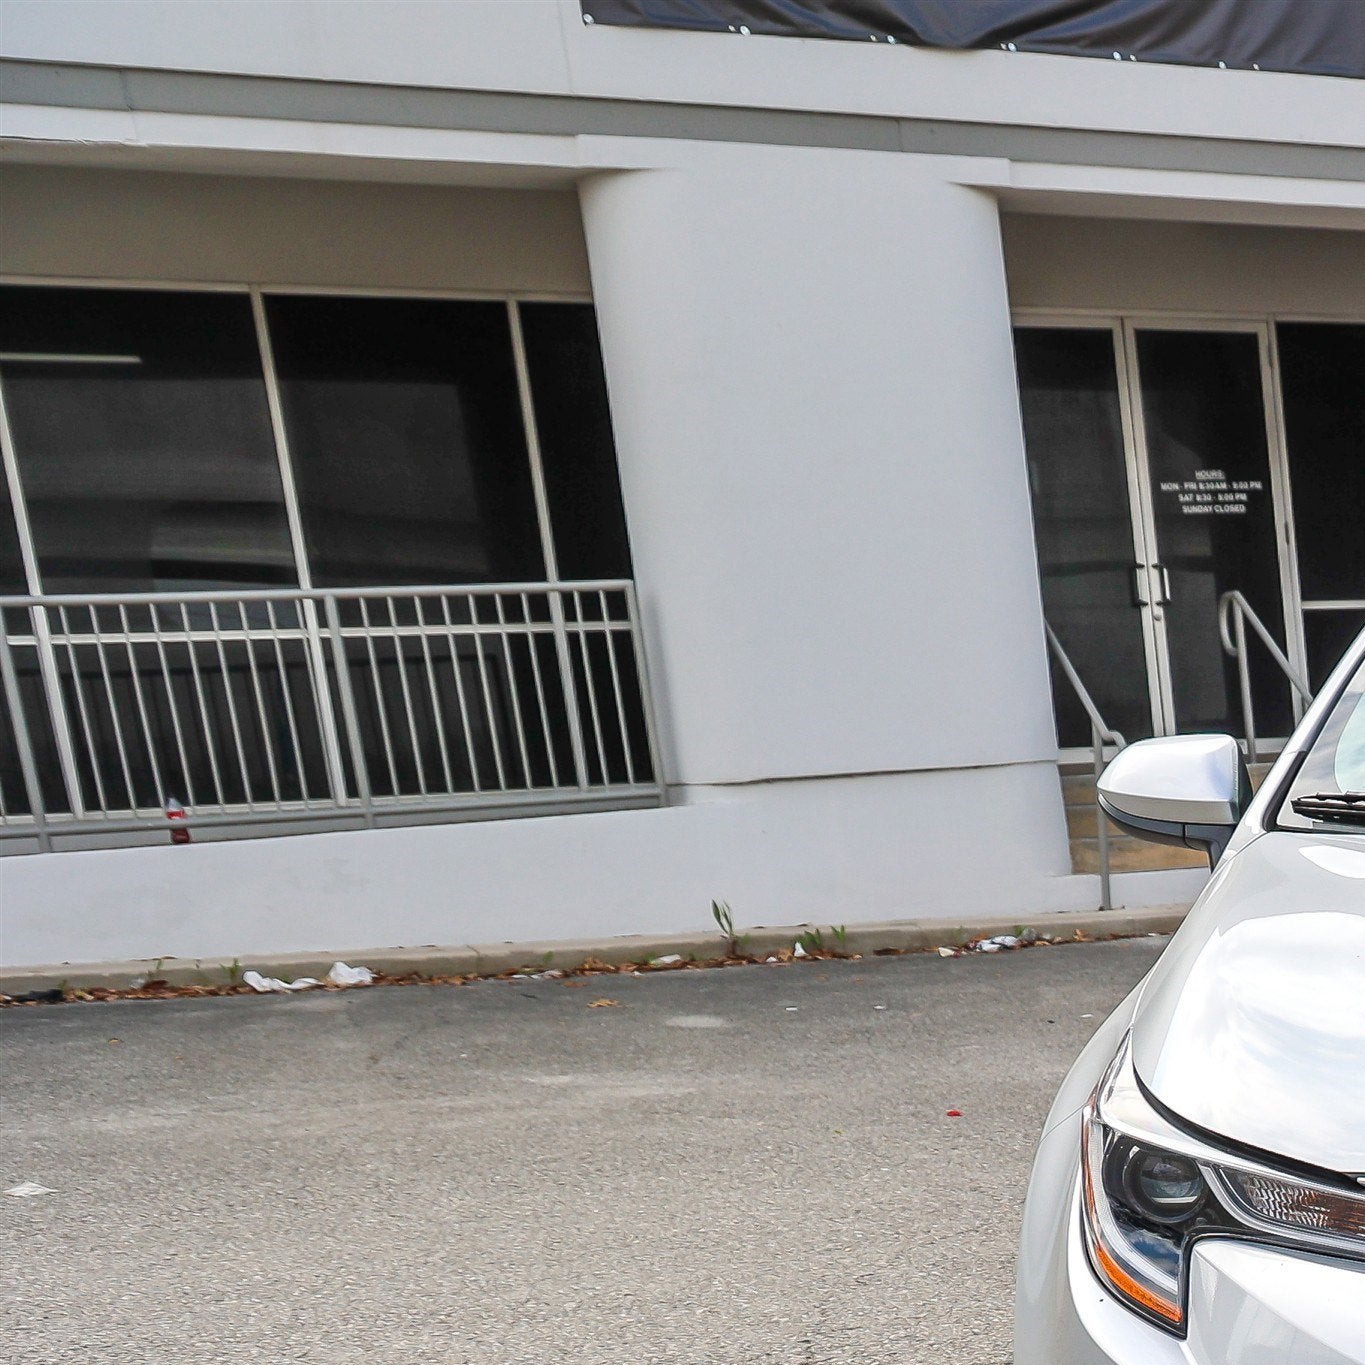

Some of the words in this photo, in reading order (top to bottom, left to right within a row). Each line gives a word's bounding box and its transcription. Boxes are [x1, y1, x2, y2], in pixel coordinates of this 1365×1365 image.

[1160, 482, 1179, 491] MON
[1184, 482, 1197, 490] FRI
[1178, 493, 1193, 502] SAT
[1234, 492, 1248, 502] PM
[1182, 504, 1213, 514] SUNDAY
[1214, 504, 1246, 514] CLOSED
